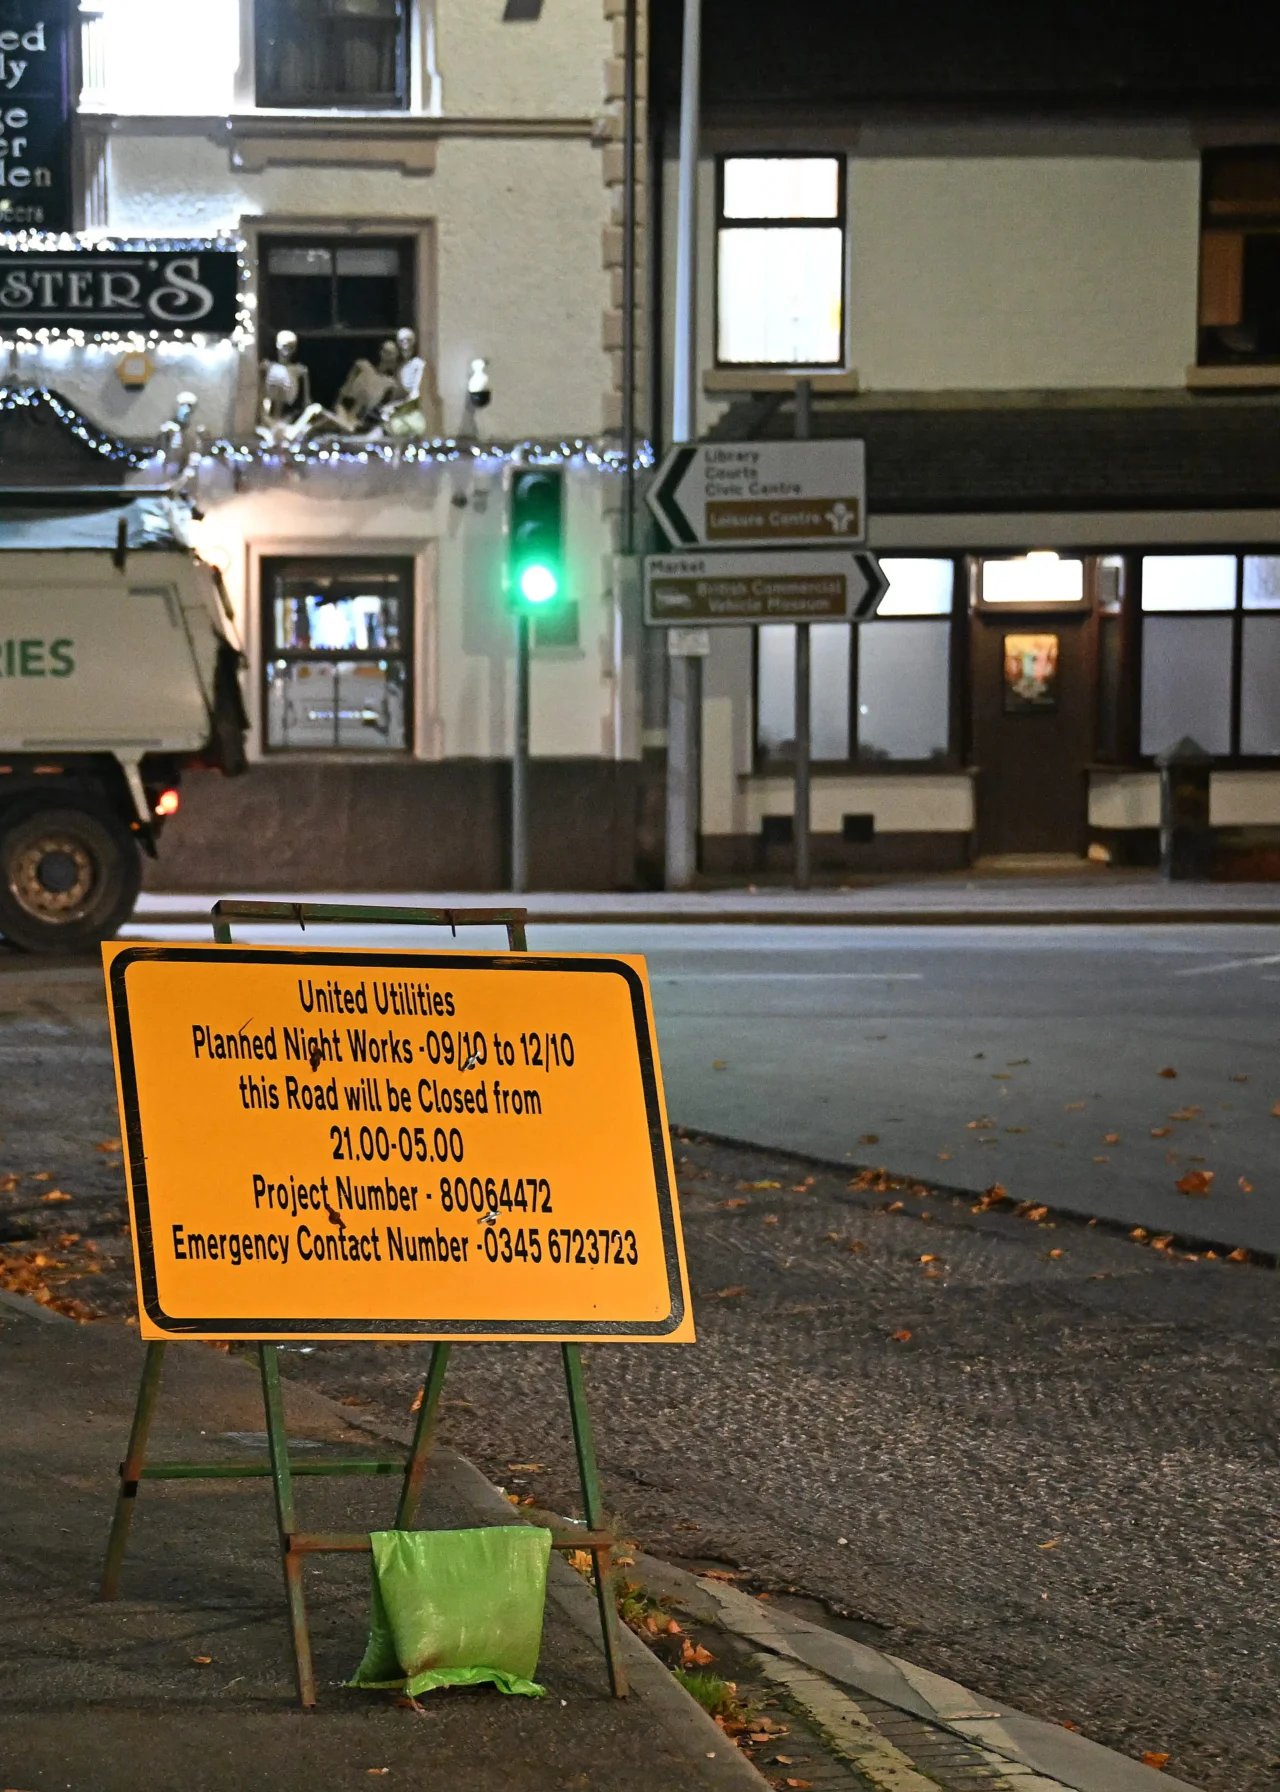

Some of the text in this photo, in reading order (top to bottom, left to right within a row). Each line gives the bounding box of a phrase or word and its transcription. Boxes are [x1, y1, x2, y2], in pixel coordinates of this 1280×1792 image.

[704, 450, 759, 464] Library
[704, 482, 801, 496] Civic Centre
[709, 511, 820, 527] Leisure Centre
[651, 560, 705, 573] Market
[298, 979, 455, 1016] United Utilities
[192, 1025, 278, 1060] Planned
[346, 1028, 413, 1064] Works
[493, 1032, 515, 1066] to
[520, 1032, 575, 1073] 12/10
[239, 1075, 542, 1115] this Road will be Closed from
[329, 1125, 464, 1163] 21.00-05.00
[252, 1174, 329, 1217] Project
[336, 1175, 418, 1211] Number
[439, 1176, 553, 1213] 80064472
[172, 1224, 289, 1266] Emergency
[297, 1225, 382, 1262] Contact
[386, 1226, 469, 1263] Number
[548, 1228, 639, 1266] 6723723
